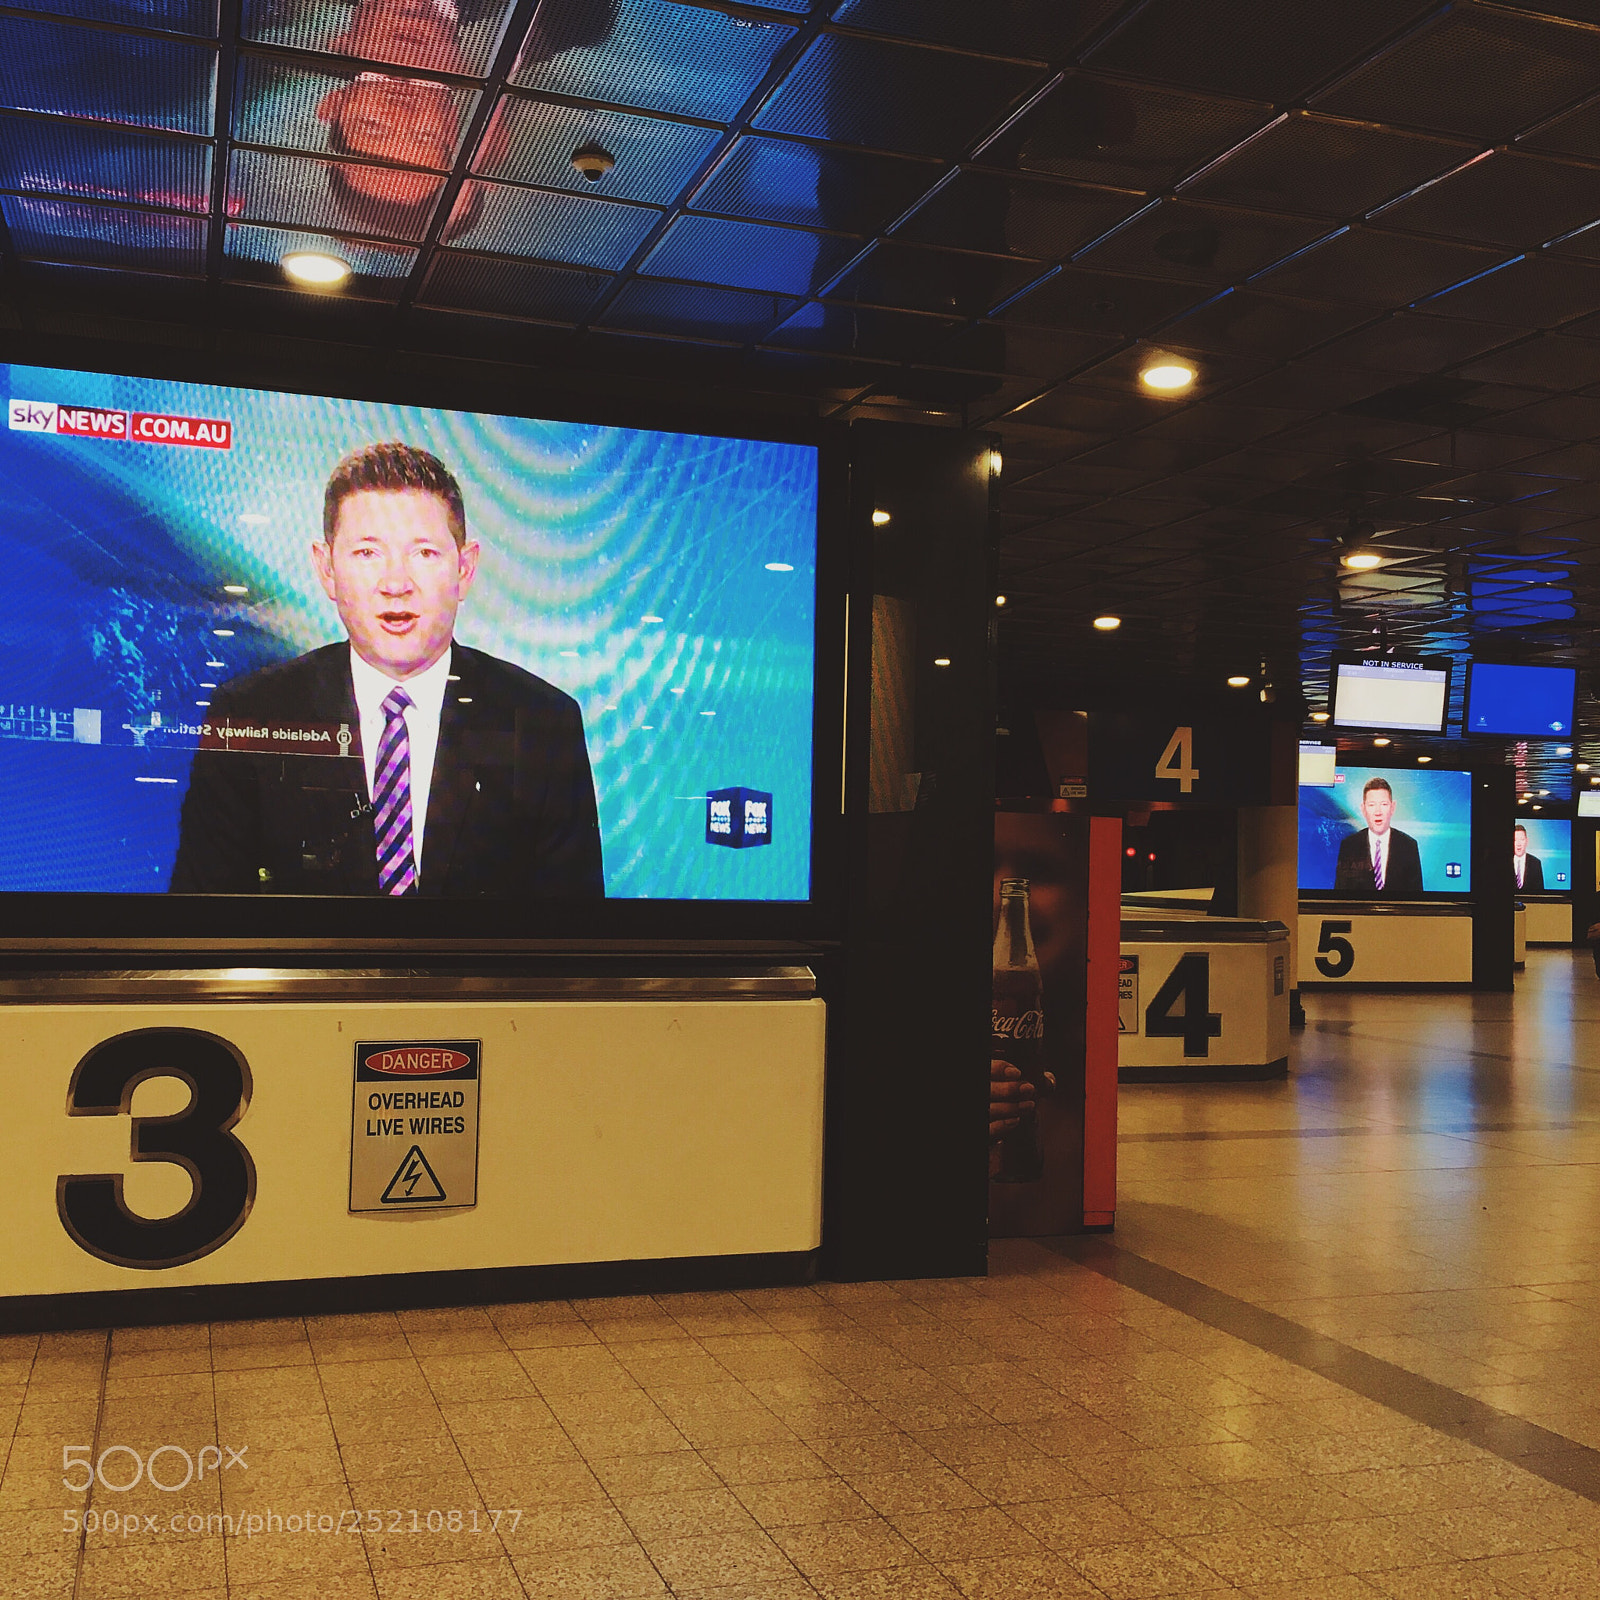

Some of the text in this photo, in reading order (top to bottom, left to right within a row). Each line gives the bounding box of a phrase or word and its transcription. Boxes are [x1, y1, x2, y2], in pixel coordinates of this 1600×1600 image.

[13, 404, 227, 443] sky NEWS .COM.AU
[1362, 659, 1379, 667] NOT
[1391, 662, 1424, 670] SERVICE
[1155, 726, 1200, 793] 4
[1314, 920, 1355, 978] 5
[1145, 952, 1222, 1058] 4
[382, 1052, 454, 1070] DANGER
[368, 1091, 465, 1111] OVERHEAD
[366, 1116, 465, 1136] LIVE WIRES
[56, 1027, 257, 1271] 3
